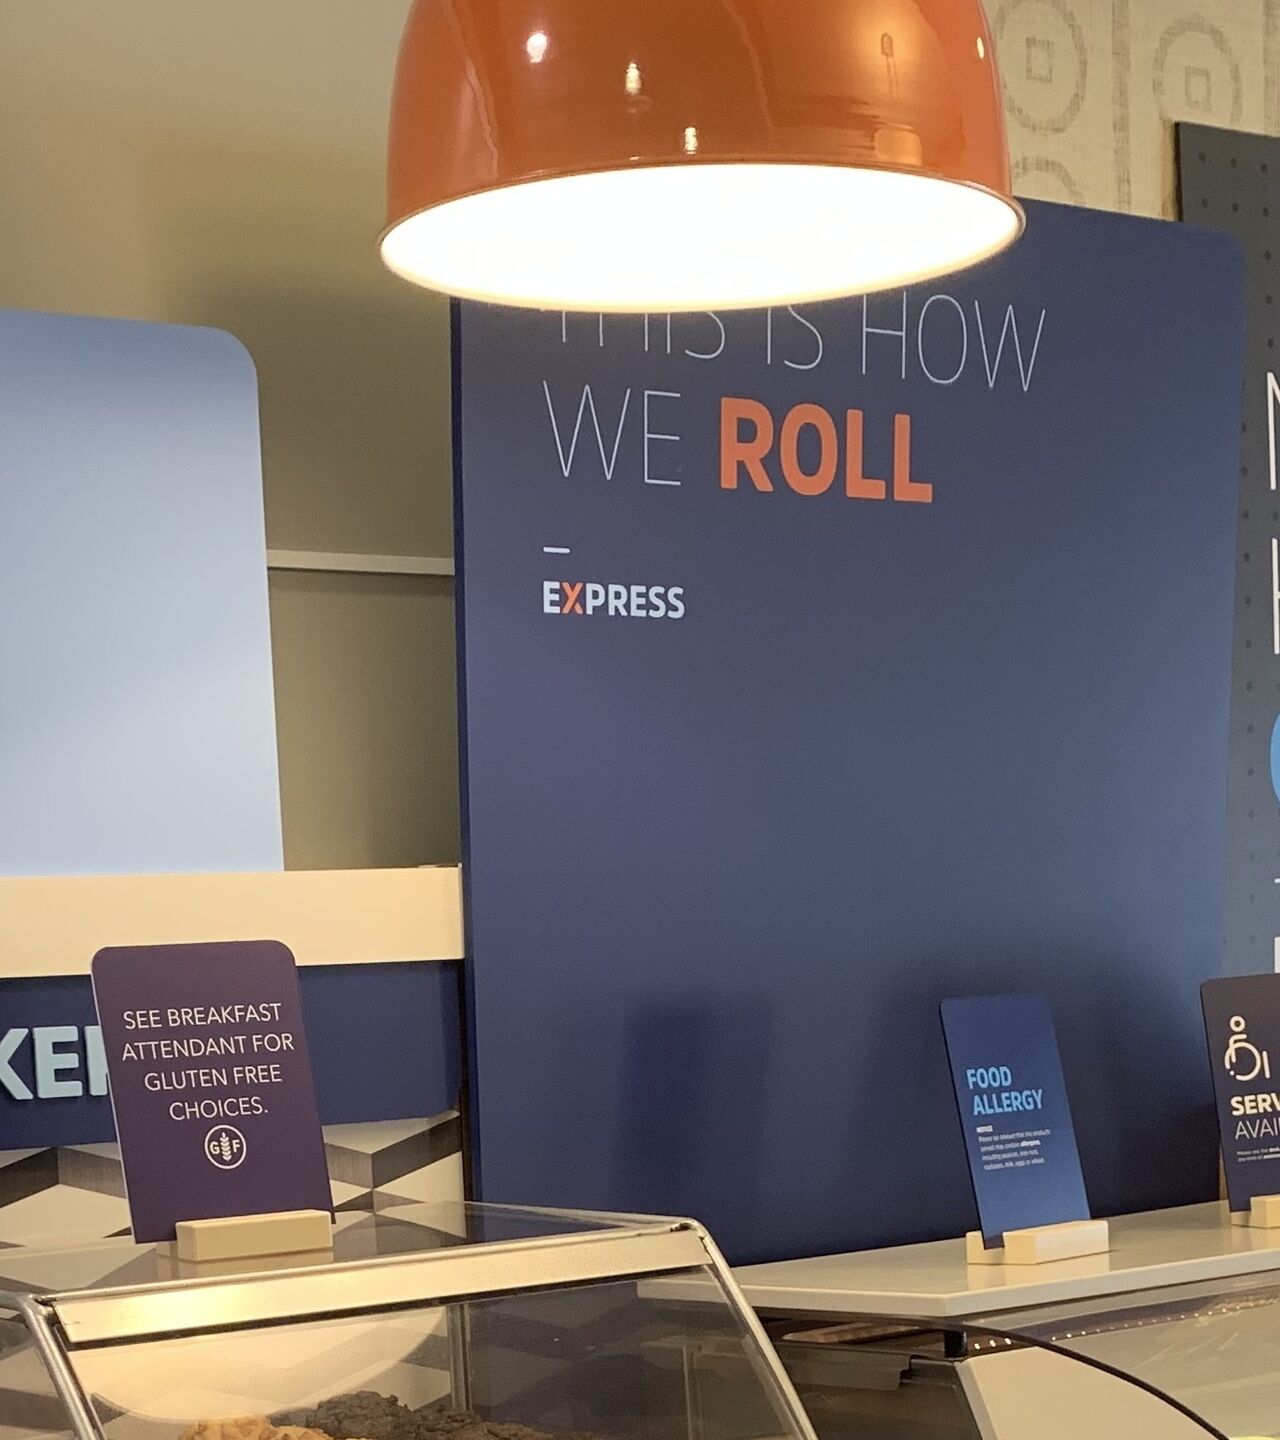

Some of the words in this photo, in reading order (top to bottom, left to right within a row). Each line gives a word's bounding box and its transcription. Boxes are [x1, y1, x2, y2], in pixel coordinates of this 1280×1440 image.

[861, 291, 1046, 392] HOW
[542, 380, 682, 486] WE
[720, 396, 933, 504] ROLL
[542, 580, 686, 619] EXPRESS
[123, 1009, 162, 1030] SEE
[167, 1003, 282, 1027] BREAKFAST
[122, 1035, 247, 1061] ATTENDANT
[252, 1033, 295, 1053] FOR
[144, 1068, 228, 1091] GLUTEN
[233, 1064, 283, 1085] FREE
[966, 1066, 1012, 1090] FOOD
[169, 1096, 269, 1121] CHOICES.
[973, 1089, 1043, 1115] ALLERGY
